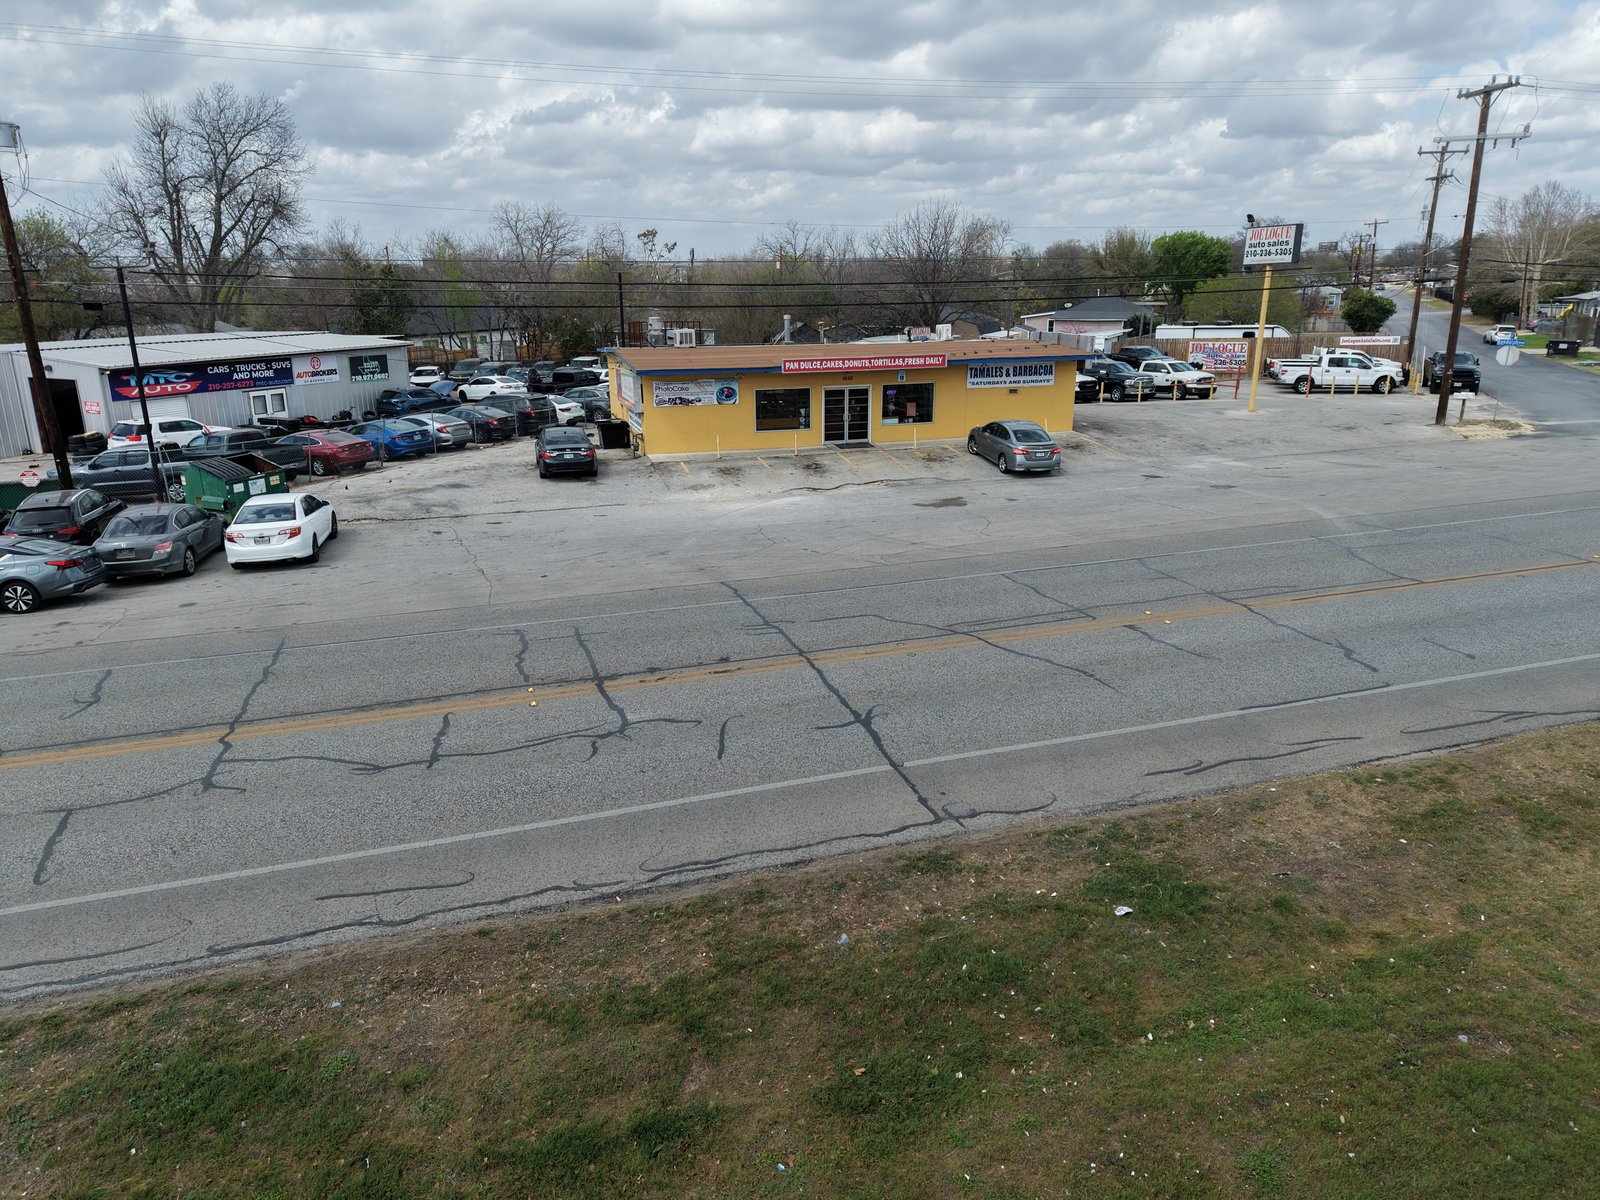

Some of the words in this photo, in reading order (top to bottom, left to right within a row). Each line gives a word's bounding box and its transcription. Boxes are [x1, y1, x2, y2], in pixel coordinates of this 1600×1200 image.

[1250, 229, 1264, 241] JOE
[1265, 226, 1292, 240] LOGUE
[1248, 241, 1266, 249] auto
[1267, 239, 1290, 247] sales
[1245, 248, 1293, 258] 210-236-5305
[1190, 343, 1209, 354] JOE
[1212, 343, 1247, 354] LOGUE
[207, 365, 230, 374] CARS
[235, 362, 266, 372] TRUCKS
[271, 361, 291, 369] SUVS
[785, 361, 799, 370] PAN
[233, 371, 251, 380] AND
[252, 370, 275, 378] MORE
[296, 368, 338, 379] AUTOBROKERS
[969, 366, 1003, 378] TAMALES
[1005, 367, 1011, 377] &
[1013, 365, 1053, 377] BARBACOA
[128, 372, 188, 387] MTC
[207, 380, 254, 391] 210-257-6273
